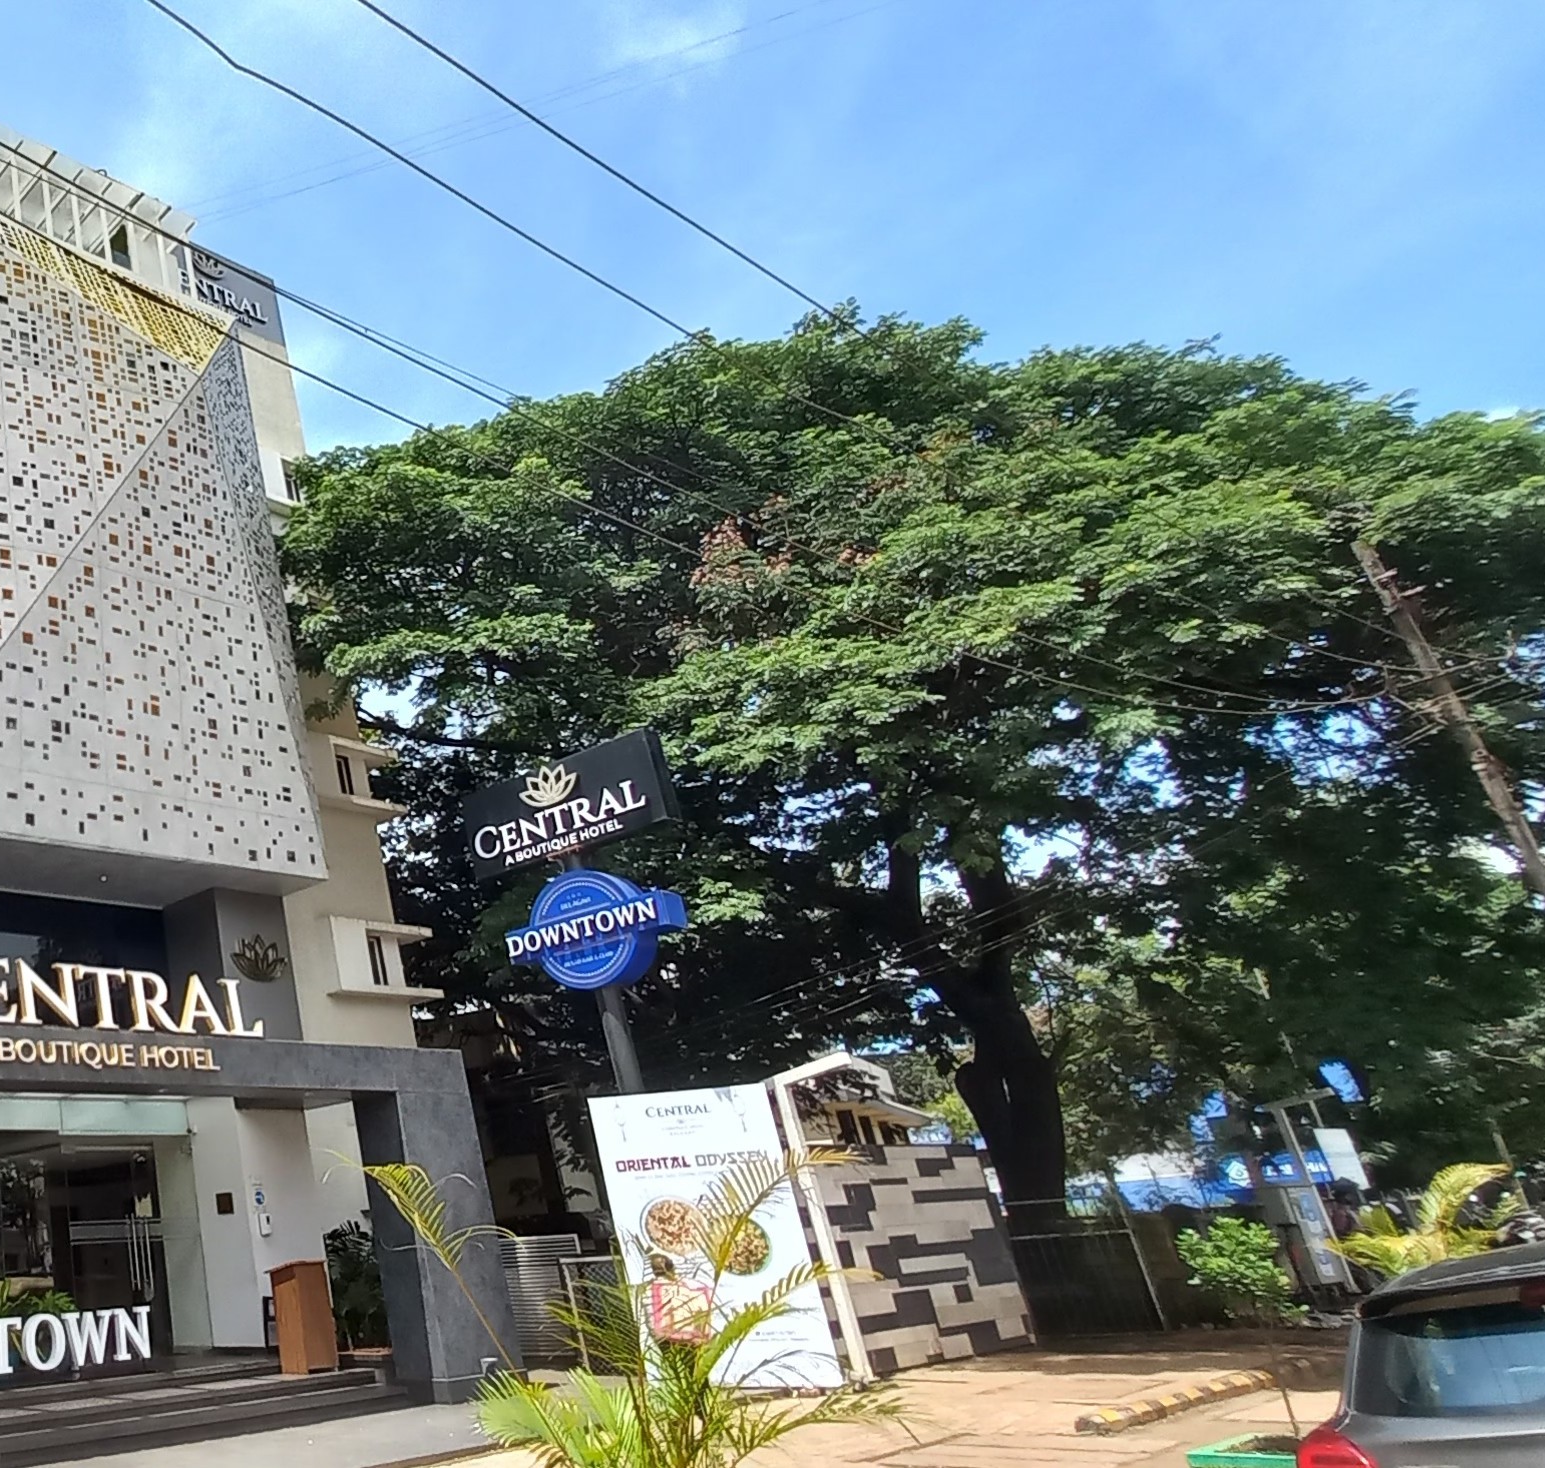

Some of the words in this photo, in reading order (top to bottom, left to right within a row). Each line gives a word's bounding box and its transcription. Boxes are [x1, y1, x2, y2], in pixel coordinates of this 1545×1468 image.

[474, 780, 646, 859] CENTRAL
[505, 851, 515, 867] A
[515, 834, 577, 862] BOUTIQUE
[579, 818, 624, 841] HOTEL
[506, 897, 656, 958] DOWNTOWN
[140, 1045, 222, 1072] HOTEL
[645, 1103, 712, 1118] CENTRAL
[615, 1155, 692, 1173] ORIENTAL
